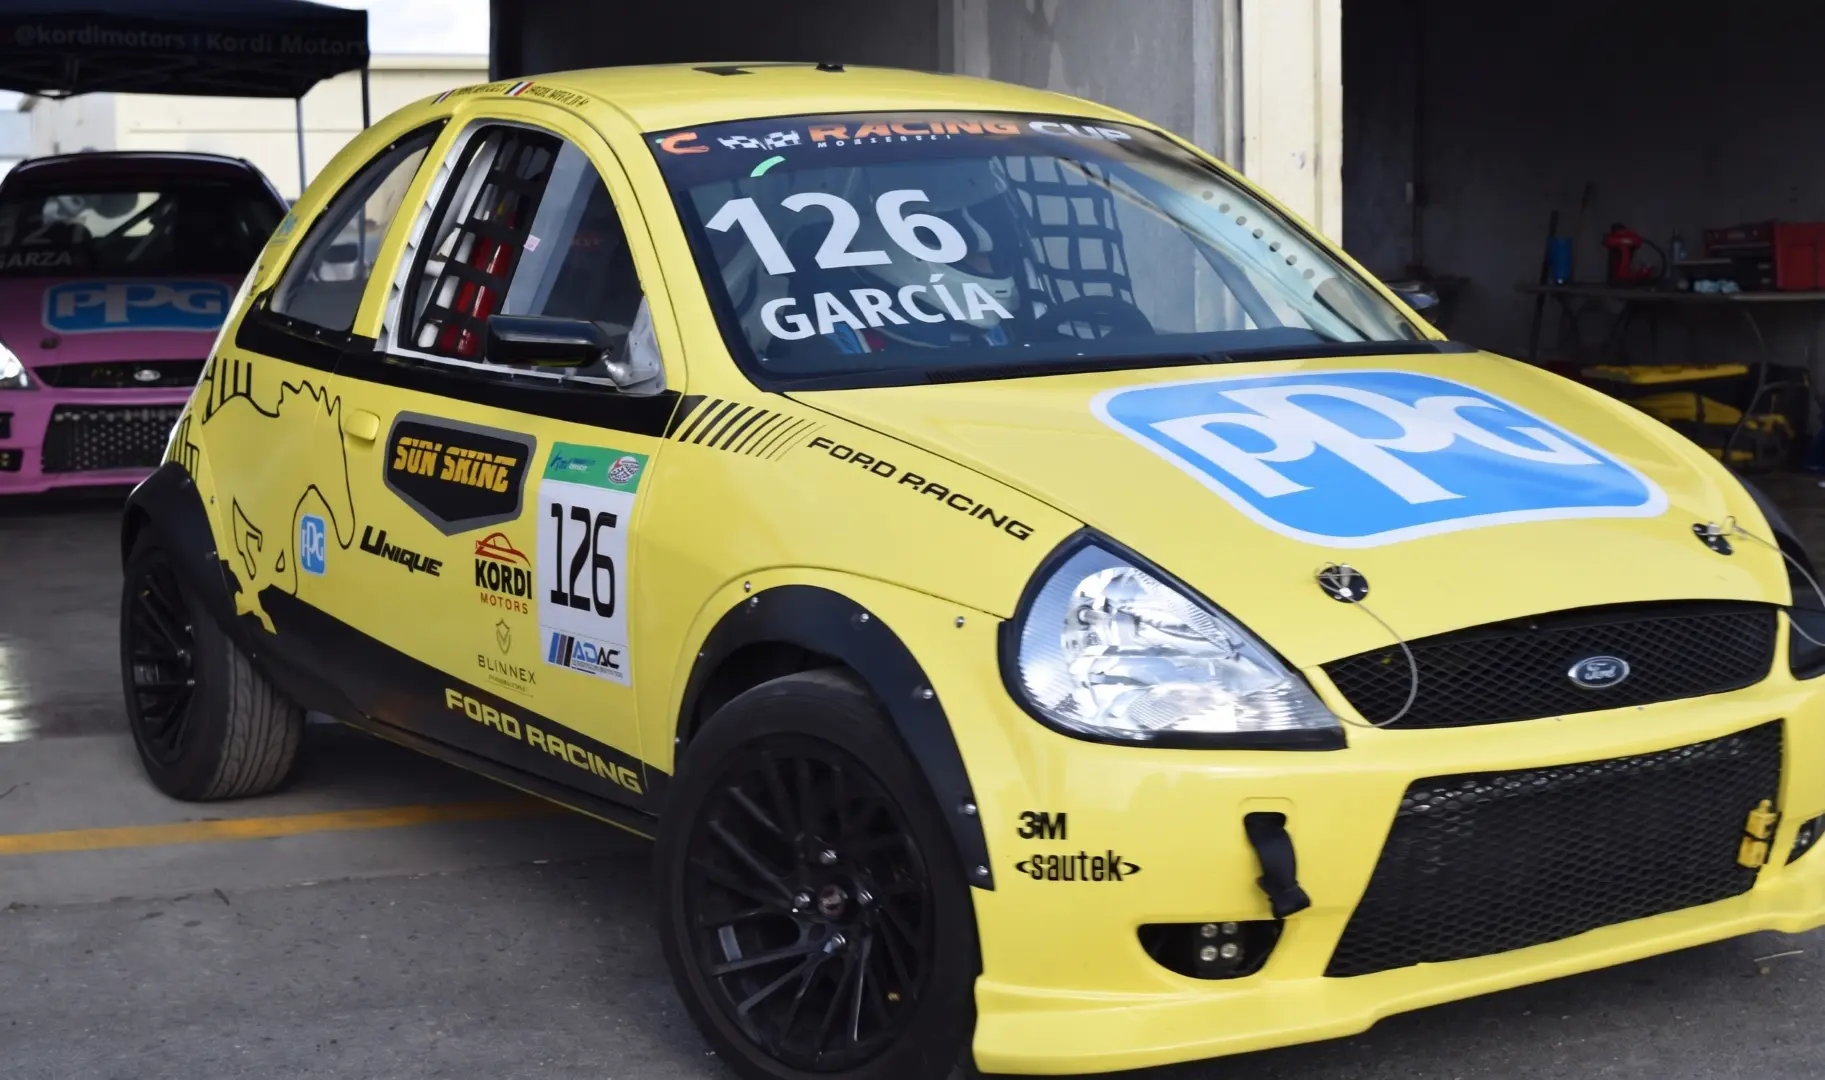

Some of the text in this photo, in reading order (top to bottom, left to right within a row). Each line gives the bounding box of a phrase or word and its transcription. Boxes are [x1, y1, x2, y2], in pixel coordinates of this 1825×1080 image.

[206, 29, 273, 53] Kordi
[808, 119, 1132, 143] RACING CUP
[705, 189, 968, 276] 126
[55, 283, 222, 323] PPG
[760, 273, 1015, 340] GARCÍA
[392, 436, 443, 477] SUN
[1147, 384, 1605, 505] PPG
[806, 436, 1035, 541] FORD RACING
[301, 521, 325, 567] PPG
[550, 502, 618, 618] 126
[475, 558, 533, 600] KORDI
[480, 592, 529, 615] MOTORS
[477, 653, 537, 686] BLINNEX
[572, 640, 620, 670] ADAC
[444, 687, 644, 795] FORD RACING
[1016, 810, 1068, 840] 3M
